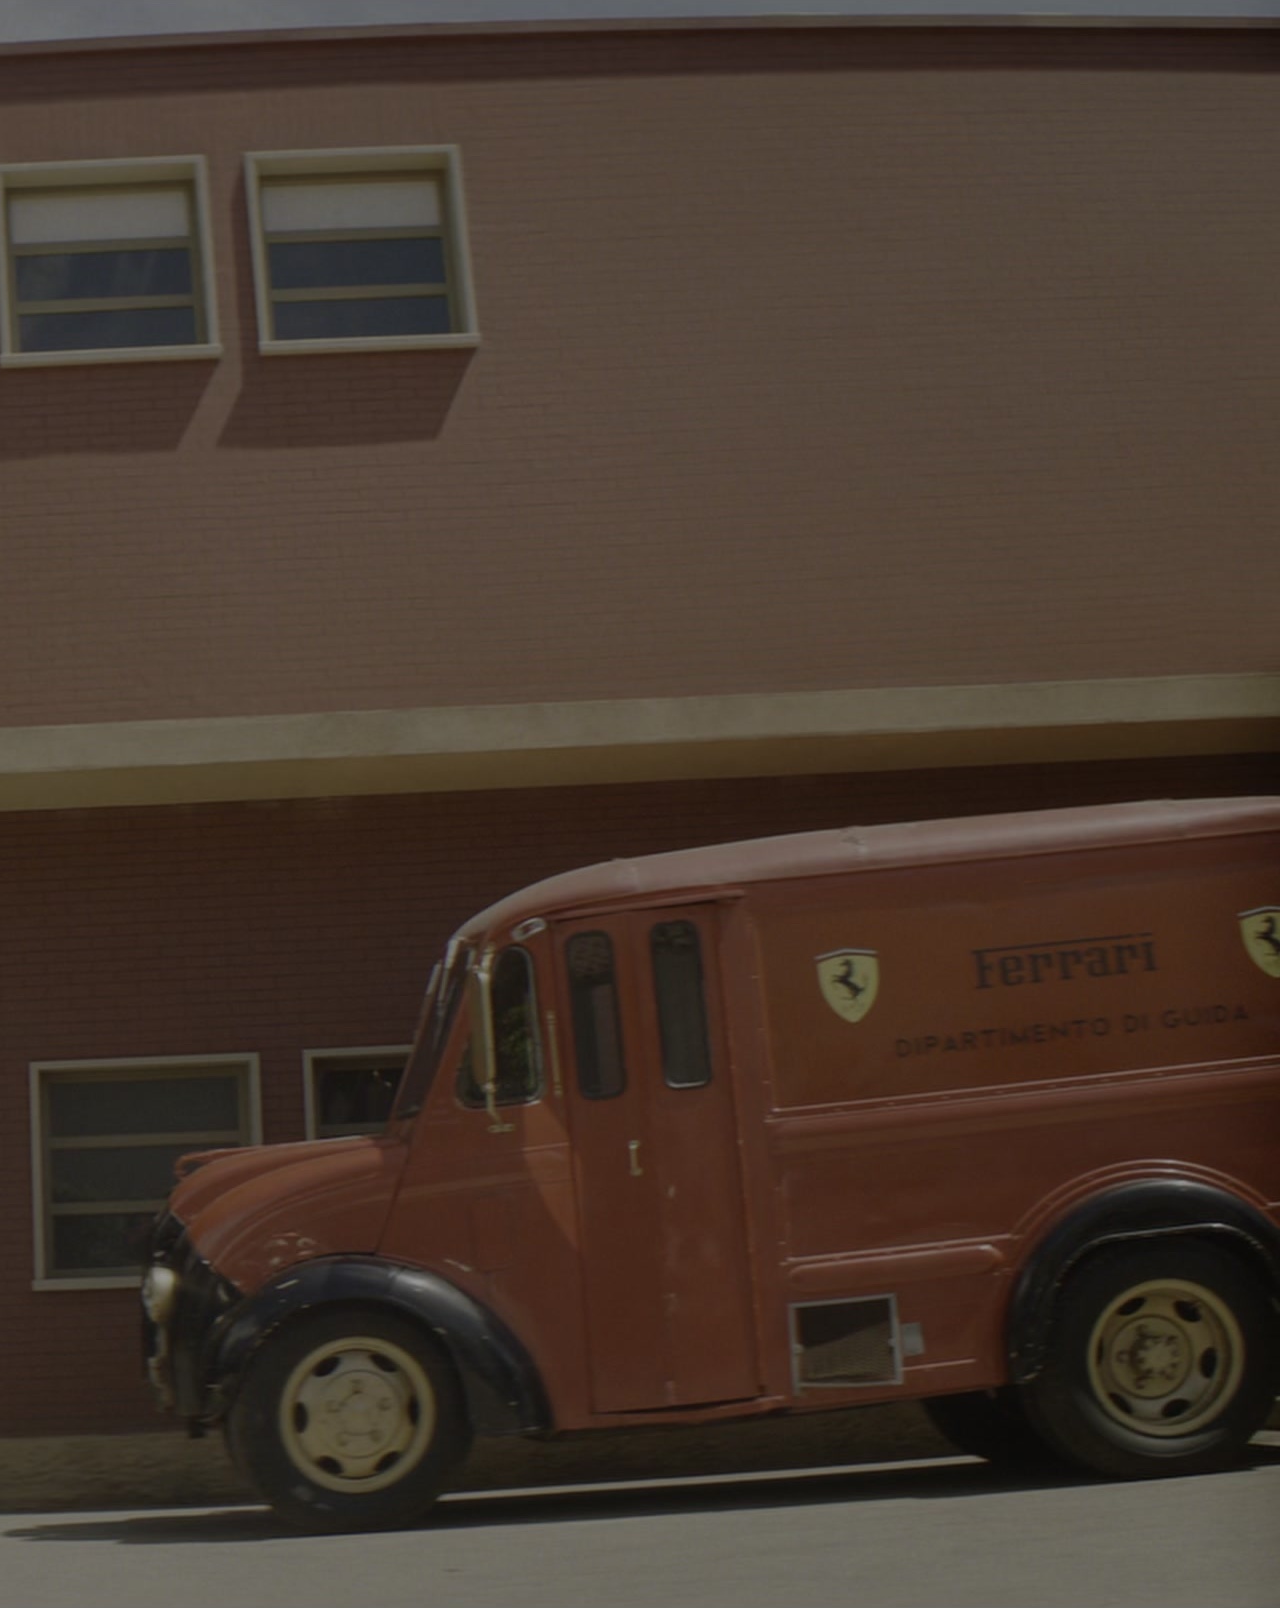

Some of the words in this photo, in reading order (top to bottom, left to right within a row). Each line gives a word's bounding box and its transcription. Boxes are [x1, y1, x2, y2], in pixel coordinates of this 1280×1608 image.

[971, 932, 1159, 990] Ferrari
[895, 1017, 1111, 1058] DIPARTIMENTO
[1123, 1013, 1149, 1034] DI
[1162, 1004, 1249, 1029] GUIDA
